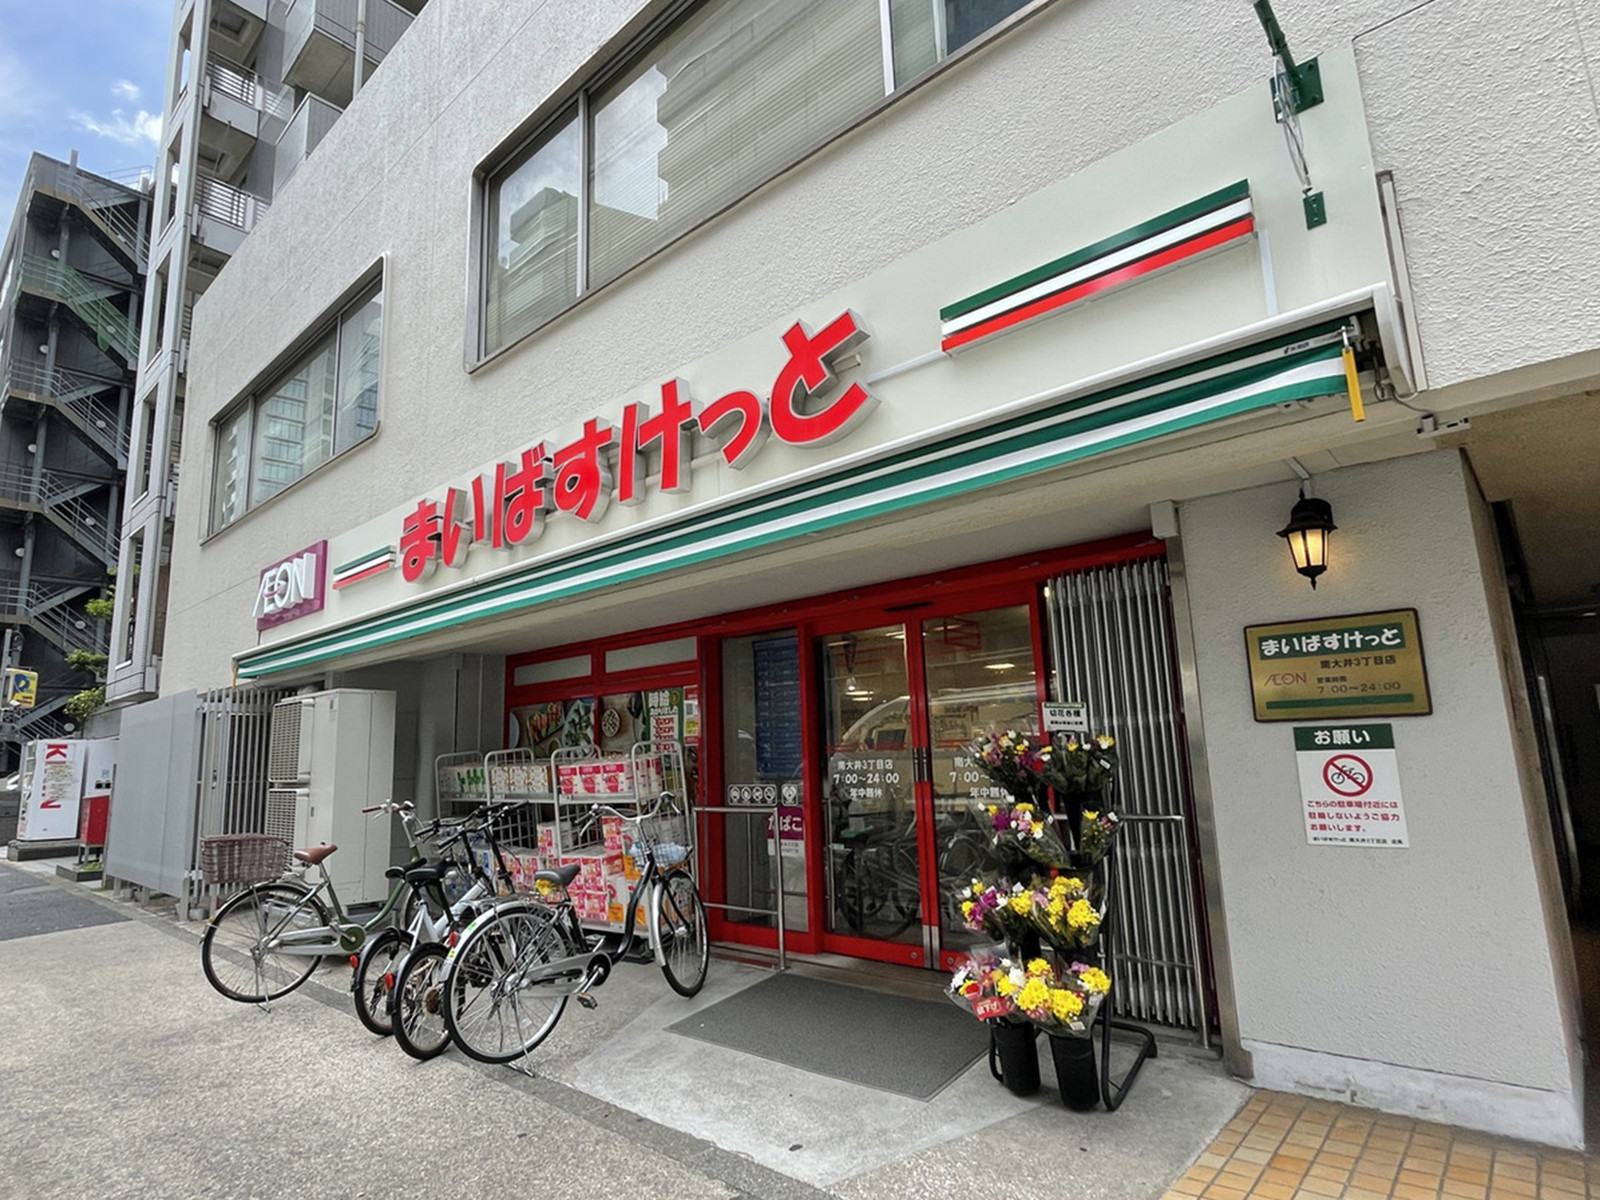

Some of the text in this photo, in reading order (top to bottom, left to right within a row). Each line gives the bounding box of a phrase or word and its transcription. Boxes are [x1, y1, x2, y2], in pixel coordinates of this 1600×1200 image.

[400, 308, 870, 584] まいばすけっと
[1261, 628, 1401, 656] まいばすけっと
[1320, 655, 1397, 669] 南大井3丁目店
[1313, 729, 1371, 745] お願い
[837, 759, 893, 770] 南大井3丁目店
[40, 743, 69, 809] KIN
